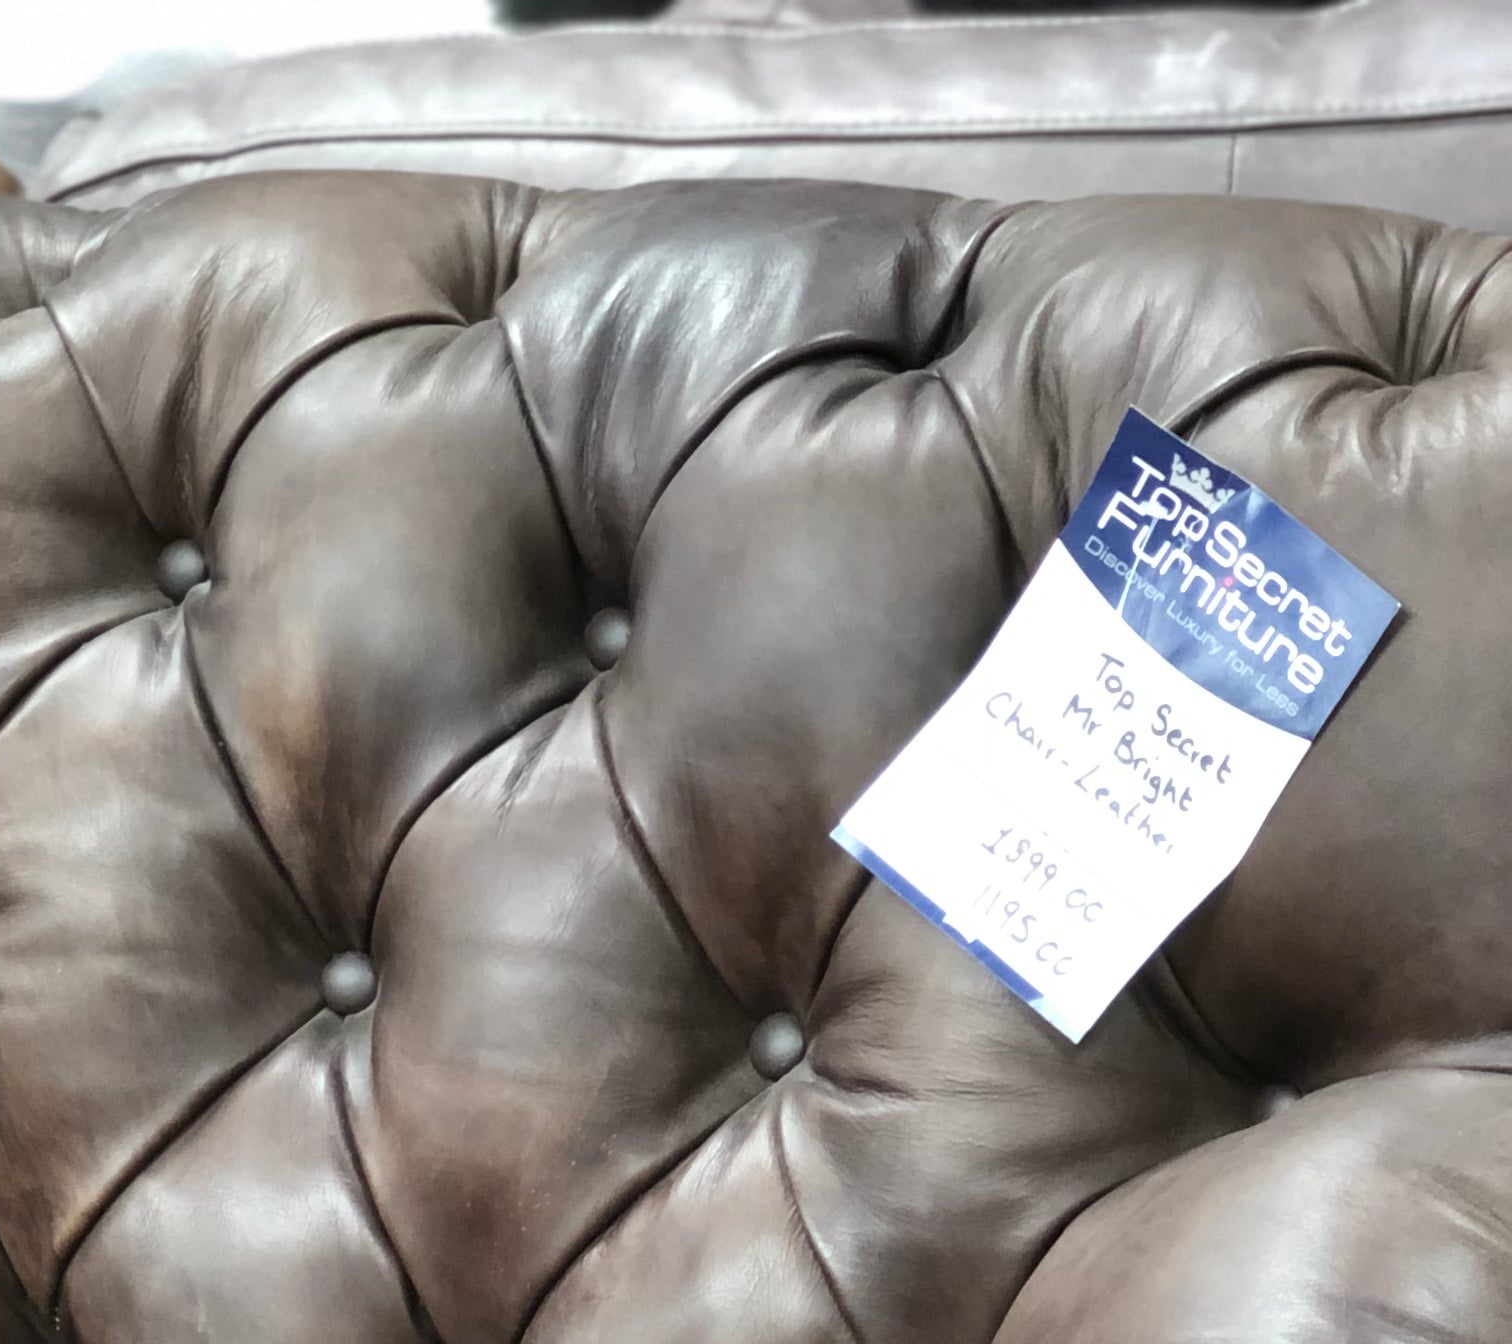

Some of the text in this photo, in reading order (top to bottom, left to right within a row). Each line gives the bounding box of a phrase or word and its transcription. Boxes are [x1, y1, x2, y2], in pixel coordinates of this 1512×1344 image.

[1084, 535, 1300, 718] Discover Luxury for Less
[1097, 491, 1324, 694] Furniture
[1062, 694, 1193, 812] Mr Bright
[1096, 653, 1231, 784] Top Secret
